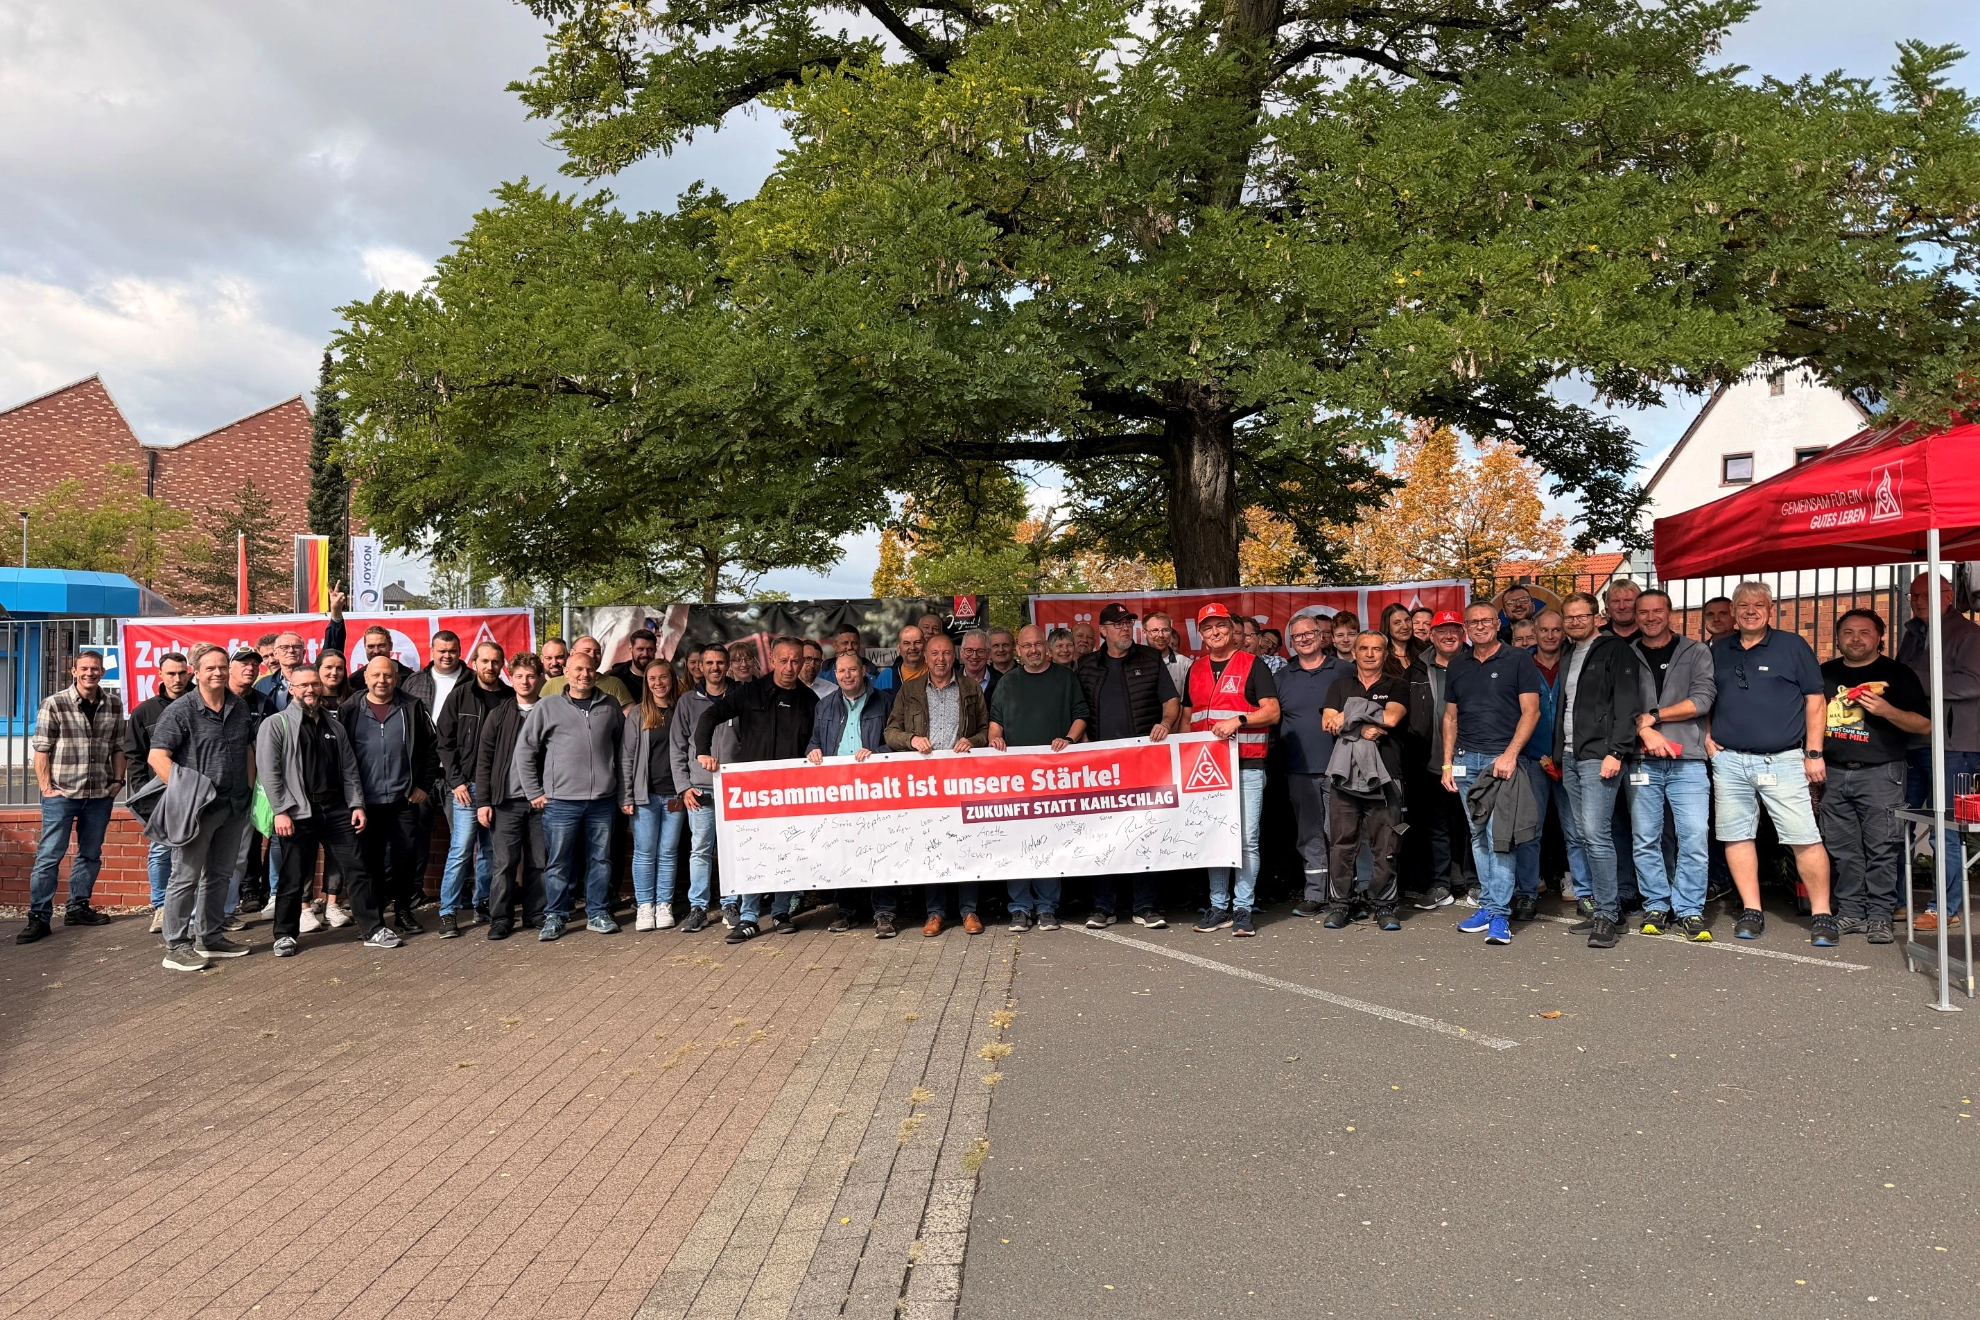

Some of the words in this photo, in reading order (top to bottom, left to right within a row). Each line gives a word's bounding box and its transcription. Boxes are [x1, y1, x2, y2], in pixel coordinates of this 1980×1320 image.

[1781, 494, 1831, 516] GEMEINSAM
[1831, 490, 1847, 508] FÜR
[1848, 488, 1863, 504] EIN
[1809, 512, 1838, 530] GUTES
[1837, 507, 1867, 526] LEBEN
[363, 545, 372, 586] JOYSON
[868, 649, 887, 664] Wir
[1849, 733, 1869, 742] MILK
[728, 776, 902, 809] Zusammenhalt
[907, 773, 938, 798] ist
[943, 774, 1026, 796] unsere
[1030, 763, 1121, 792] Stärke!
[966, 802, 1030, 820] ZUKUNFT
[1033, 798, 1077, 815] STATT
[1080, 790, 1174, 812] KAHLSCHLAG
[958, 845, 993, 859] Steven
